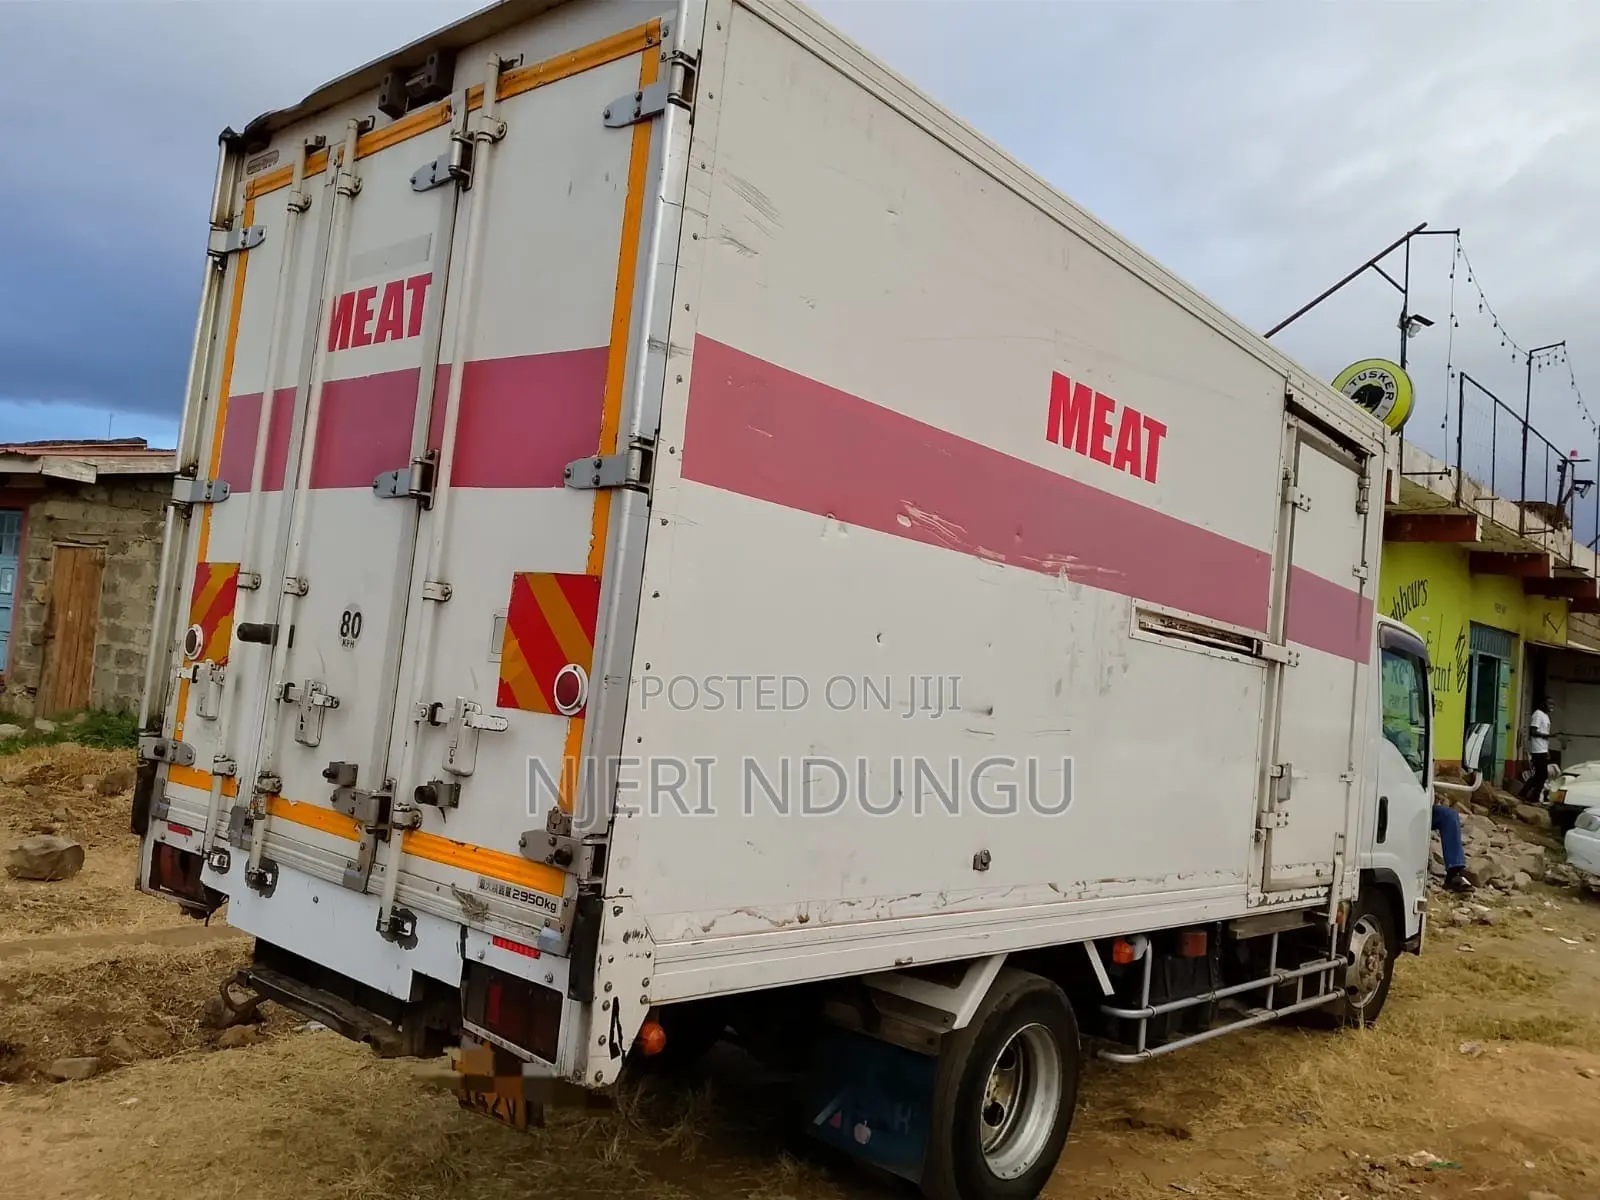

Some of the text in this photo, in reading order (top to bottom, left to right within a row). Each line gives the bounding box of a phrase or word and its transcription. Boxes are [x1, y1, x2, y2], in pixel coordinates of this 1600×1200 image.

[328, 272, 433, 352] MEAT
[1348, 370, 1395, 401] TUSKER
[1045, 370, 1168, 484] MEAT
[340, 610, 362, 639] 80
[342, 638, 355, 649] KPH
[512, 888, 557, 914] 2950kg
